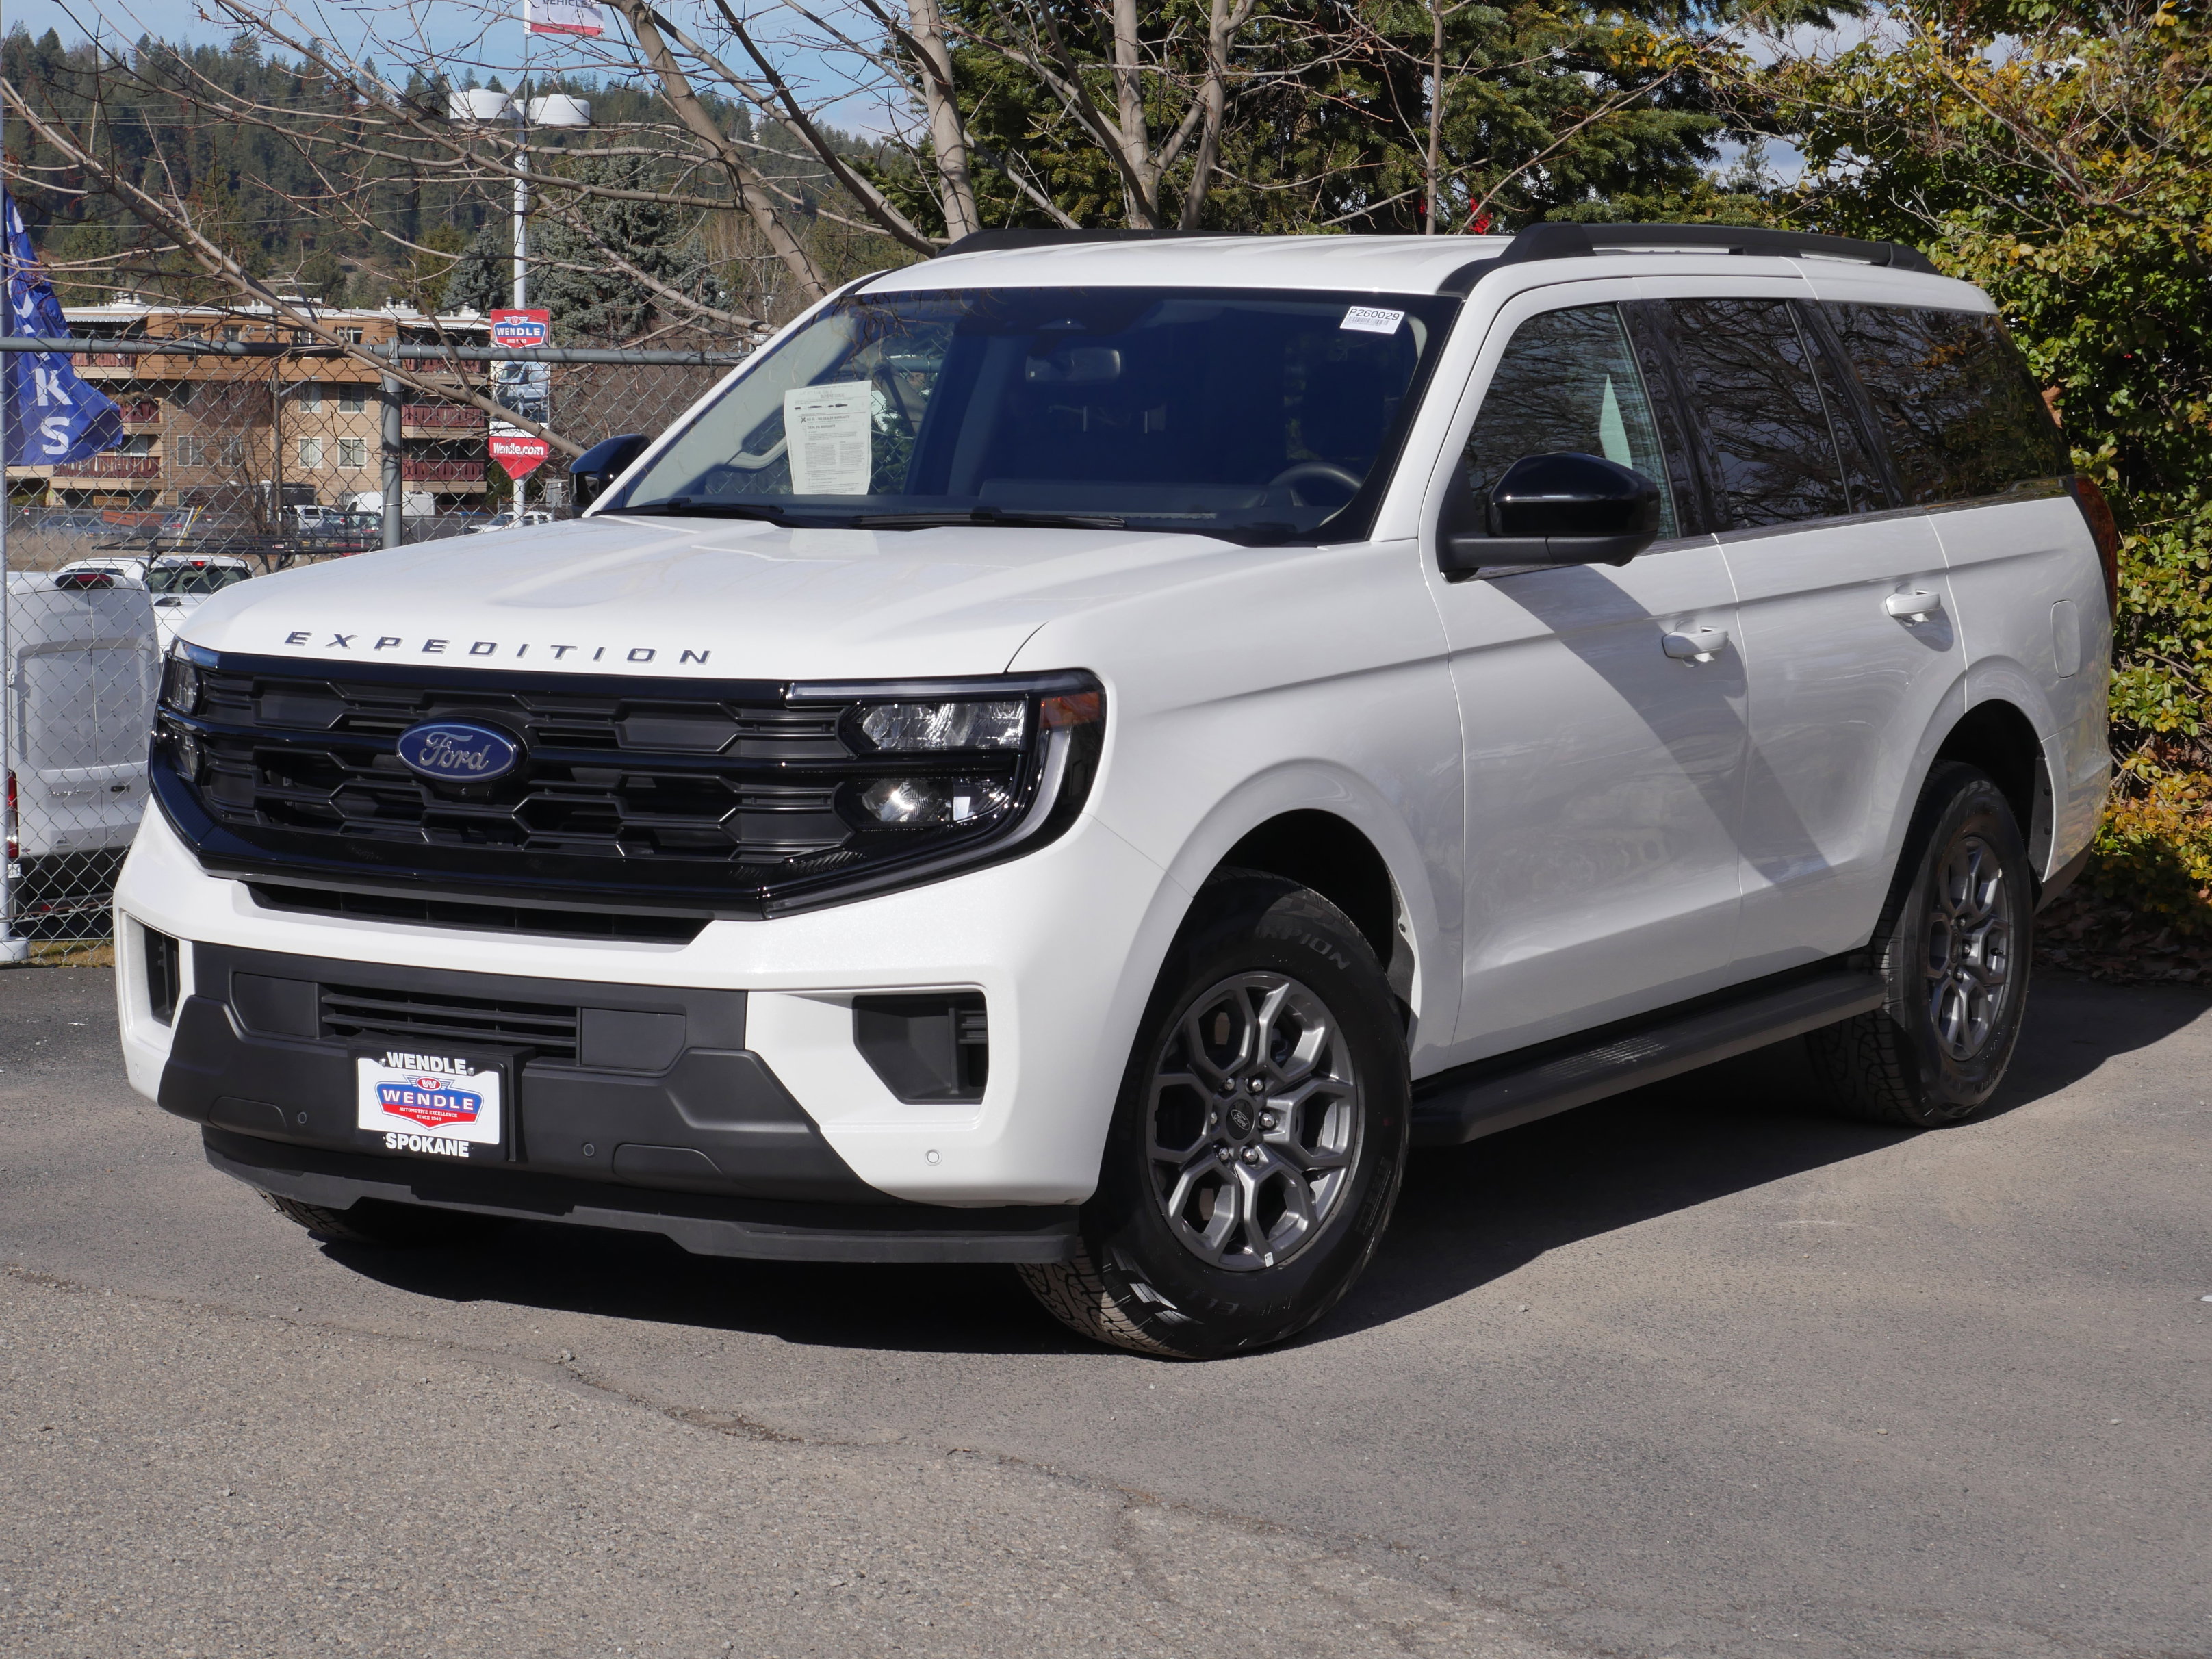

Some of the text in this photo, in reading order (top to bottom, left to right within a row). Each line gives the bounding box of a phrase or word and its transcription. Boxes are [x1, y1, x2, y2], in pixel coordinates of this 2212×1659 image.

[1348, 308, 1400, 320] P260029
[496, 327, 541, 335] WENDLE
[493, 443, 544, 455] Wendle.com
[285, 631, 712, 665] EXPEDITION
[419, 731, 491, 770] Ford
[386, 1051, 467, 1075] WENDLE
[383, 1089, 474, 1111] WENDLE
[1233, 1112, 1248, 1128] Ford
[385, 1133, 470, 1157] SPOKANE
